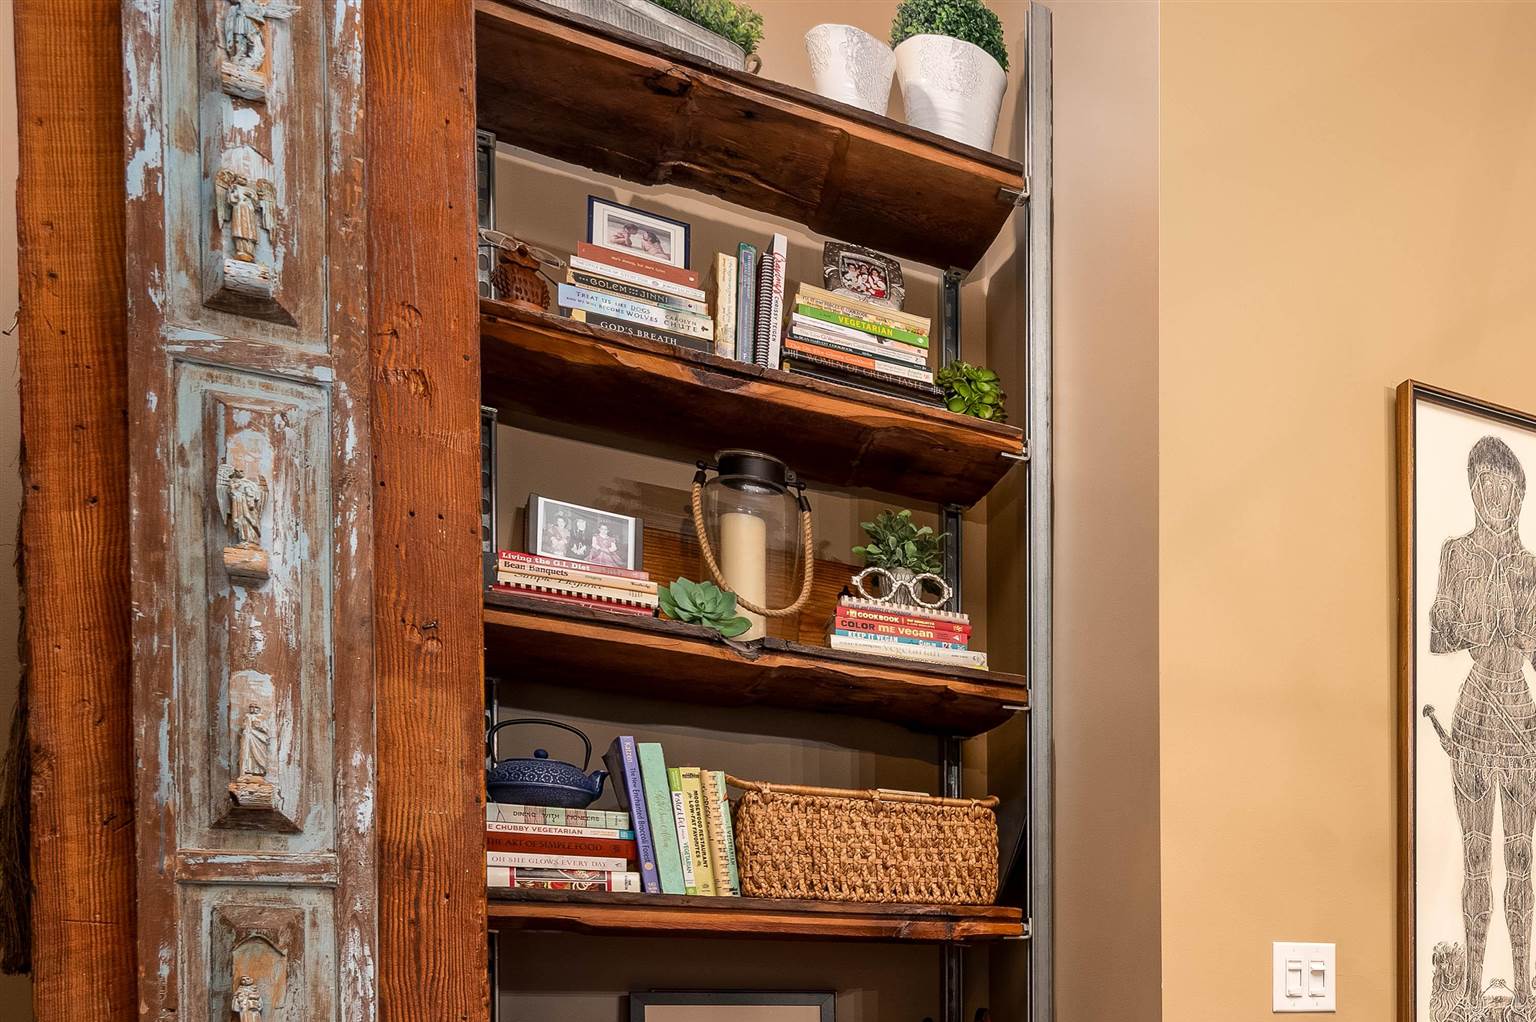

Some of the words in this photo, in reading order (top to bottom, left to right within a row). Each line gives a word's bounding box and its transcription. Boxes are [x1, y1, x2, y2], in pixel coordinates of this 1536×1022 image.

[590, 278, 627, 294] GOLEM
[639, 291, 668, 303] JINNI
[576, 290, 598, 302] TREAT
[601, 297, 612, 305] US
[615, 301, 627, 310] LIKE
[630, 305, 651, 315] DOGS
[598, 302, 625, 315] BECOME
[627, 309, 658, 323] WOLVES
[771, 296, 779, 320] CHRISSY
[663, 319, 698, 333] CHUTE
[665, 313, 697, 326] CAROLYN
[838, 316, 893, 337] VEGETARIAN
[600, 320, 633, 336] GOD'S
[637, 330, 677, 346] BREATH
[770, 321, 778, 342] TEIGEN
[501, 552, 532, 563] Living
[535, 557, 551, 565] the
[571, 562, 591, 572] Diet
[503, 561, 526, 570] Bean
[529, 564, 569, 577] Banquets
[858, 612, 899, 624] COOKBOOK
[840, 619, 875, 630] COLOR
[898, 627, 934, 639] vegan
[848, 631, 867, 640] KEEP
[878, 634, 898, 643] VEGAN
[624, 741, 633, 763] Katzen
[513, 810, 536, 818] DINING
[632, 789, 643, 819] Enchanted
[688, 800, 697, 825] LOW-FAT
[495, 824, 530, 832] CHUBBY
[531, 827, 583, 835] VEGETARIAN
[638, 820, 647, 845] Broccoli
[693, 790, 703, 829] MOOSEWOOD
[699, 829, 709, 868] RESTAURANT
[506, 838, 524, 847] ART
[525, 840, 537, 848] OF
[575, 842, 603, 851] FOOD
[692, 827, 701, 859] FAVORITES
[528, 858, 559, 866] GLOWS
[561, 859, 589, 867] EVERY
[642, 846, 650, 863] Forest
[683, 842, 692, 874] VEGETARIAN
